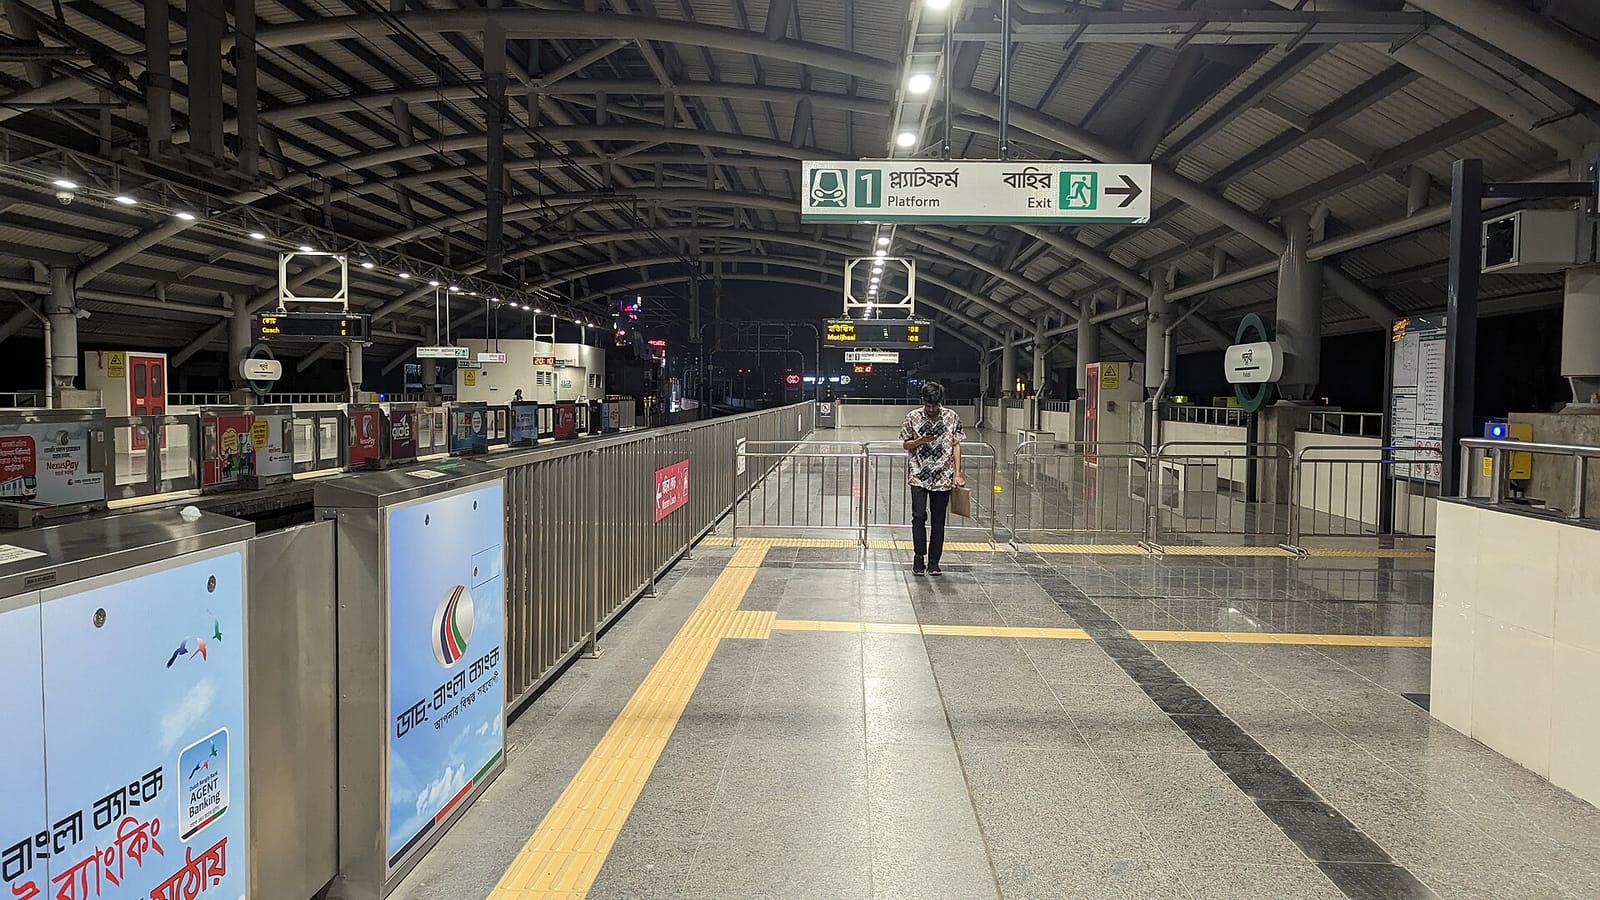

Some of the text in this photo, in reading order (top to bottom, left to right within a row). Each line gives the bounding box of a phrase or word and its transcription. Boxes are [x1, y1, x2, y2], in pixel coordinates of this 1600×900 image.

[860, 172, 874, 205] 1
[888, 166, 959, 189] প্ল্যাটফর্ম
[1002, 167, 1052, 189] বাহির
[887, 195, 940, 208] Platform
[1027, 197, 1052, 208] Exit
[46, 460, 79, 471] NexusPay
[469, 646, 500, 683] ব্যাংক
[93, 766, 163, 830] ব্যাংক
[189, 790, 221, 818] Banking
[190, 778, 218, 805] AGENT
